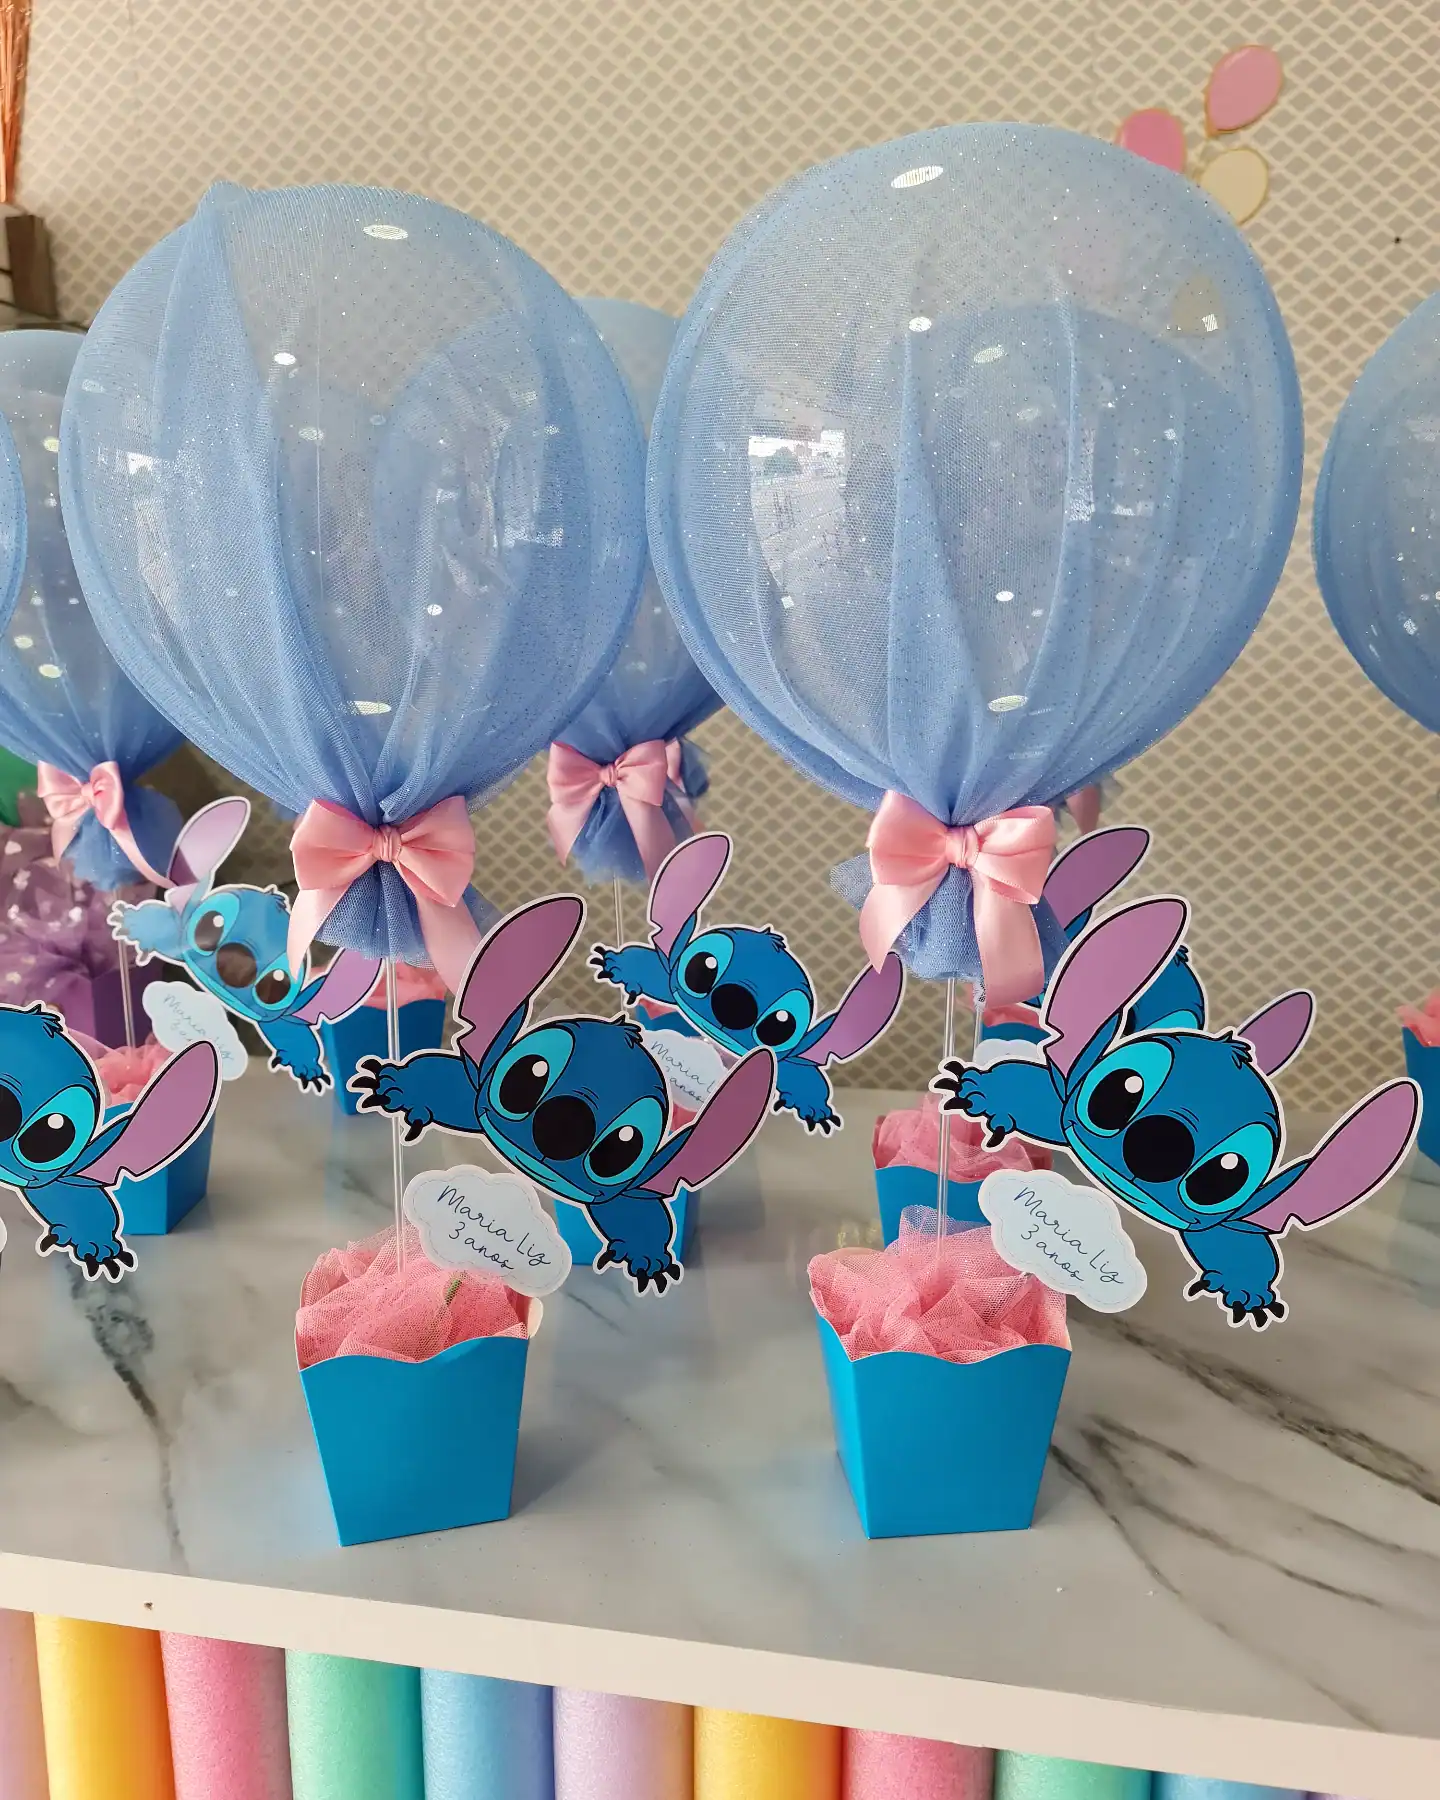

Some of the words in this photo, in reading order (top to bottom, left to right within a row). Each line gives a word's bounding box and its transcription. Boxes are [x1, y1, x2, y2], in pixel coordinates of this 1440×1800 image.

[650, 1041, 703, 1084] Maria
[669, 1077, 705, 1104] anos
[437, 1185, 514, 1242] Maria
[516, 1232, 552, 1266] Liz
[448, 1221, 466, 1240] 3
[464, 1236, 515, 1270] anos
[1014, 1186, 1088, 1255] Maria
[1089, 1249, 1124, 1284] Liz
[1020, 1223, 1040, 1240] 3
[1035, 1241, 1085, 1282] anos
